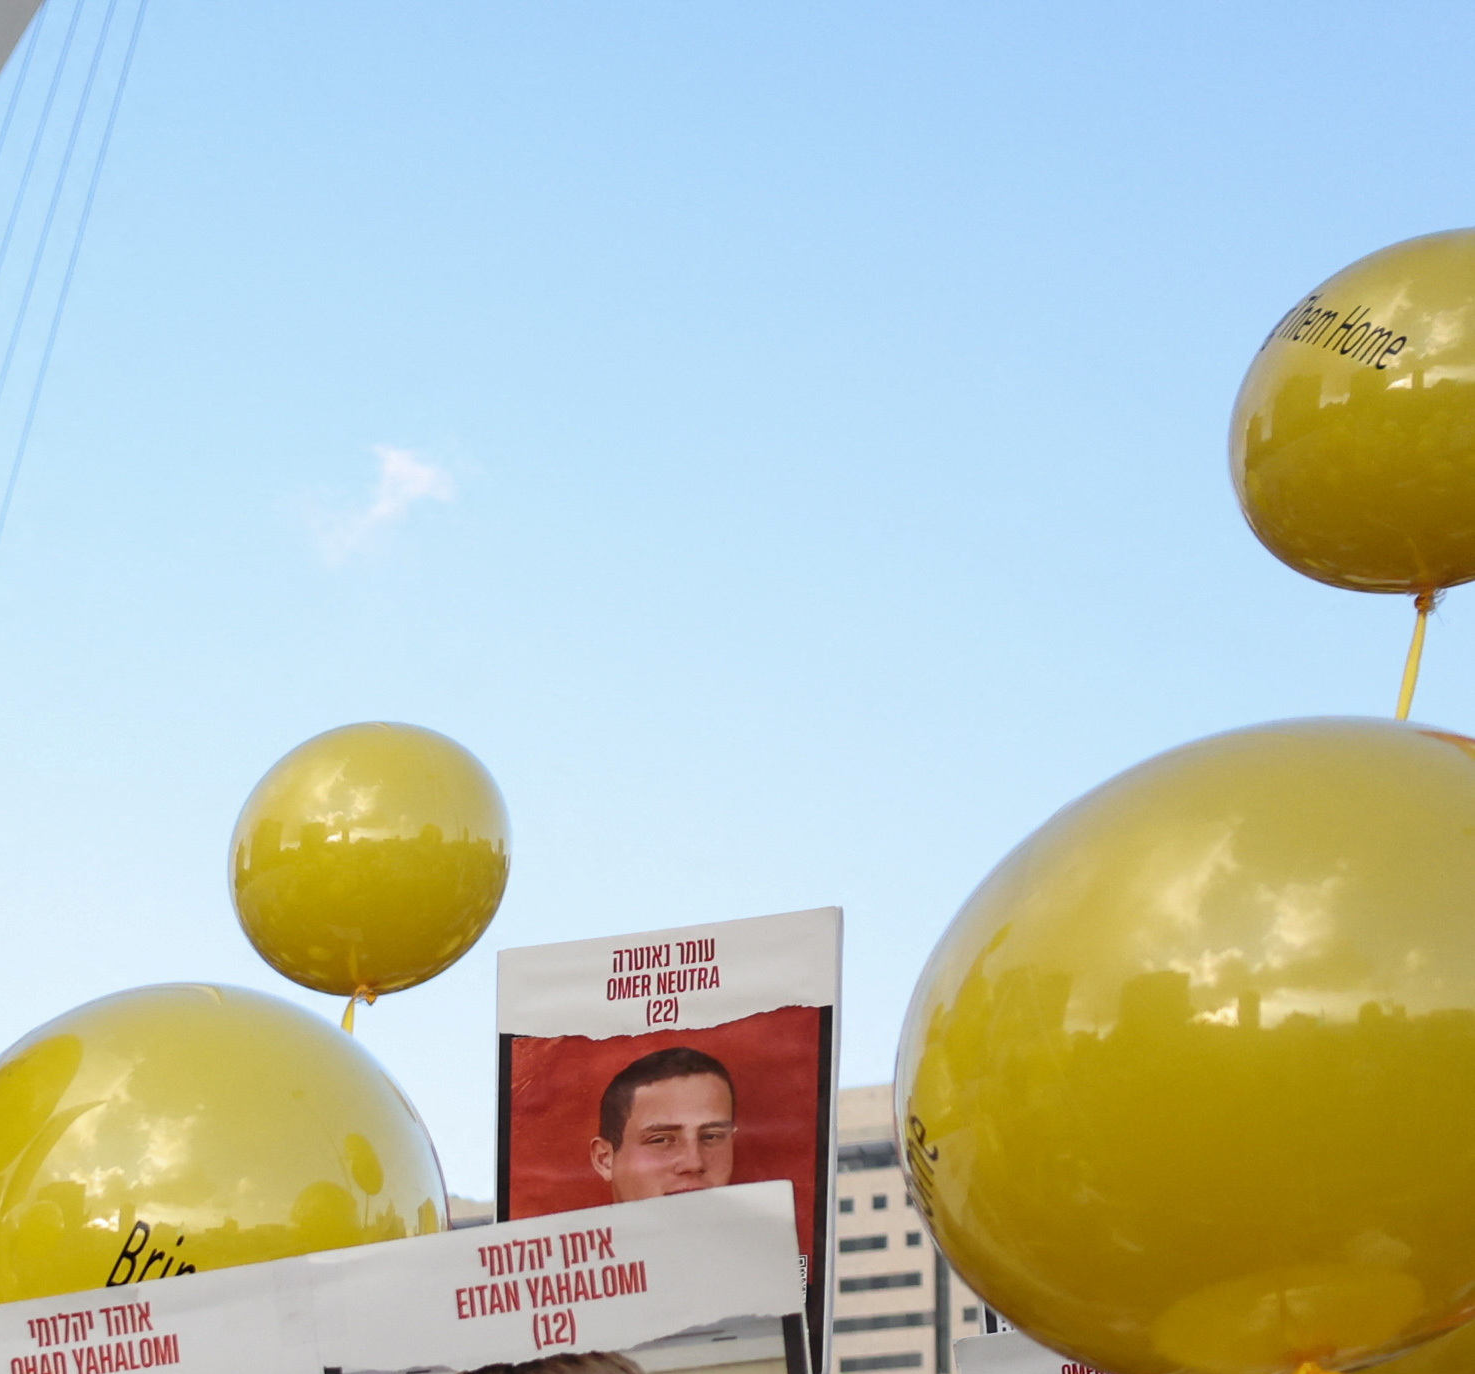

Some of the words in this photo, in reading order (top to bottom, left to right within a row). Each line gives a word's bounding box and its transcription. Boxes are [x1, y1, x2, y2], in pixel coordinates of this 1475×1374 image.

[1324, 305, 1407, 370] Home
[613, 944, 671, 973] נאוטרה
[676, 938, 715, 965] עומר
[607, 975, 651, 1001] OMER
[656, 966, 720, 995] NEUTRA
[646, 996, 679, 1026] (22)
[477, 1237, 564, 1273] יהלומי
[572, 1227, 614, 1266] איתן
[455, 1276, 516, 1320] EITAN
[520, 1260, 648, 1310] YAHALOMI
[27, 1310, 95, 1344] יהלומי
[101, 1300, 153, 1338] אוהד
[532, 1308, 577, 1351] (12)
